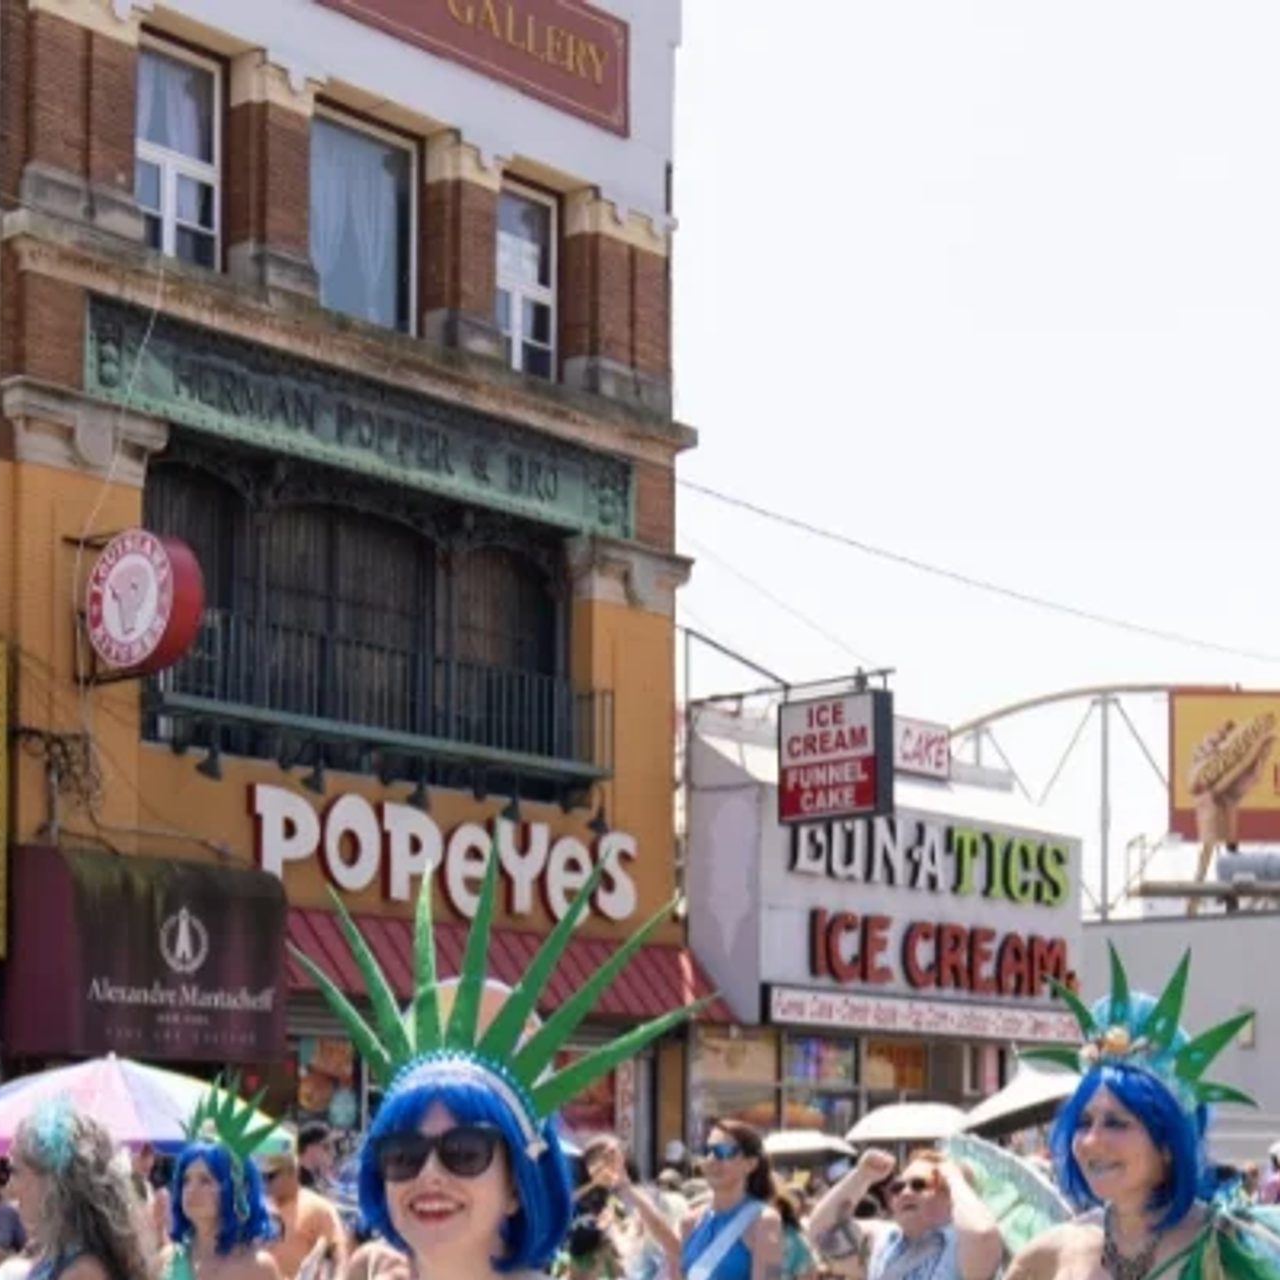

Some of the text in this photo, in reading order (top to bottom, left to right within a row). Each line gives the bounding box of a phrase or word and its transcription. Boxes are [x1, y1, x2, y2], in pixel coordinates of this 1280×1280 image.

[447, 0, 608, 86] GALLERY
[336, 400, 455, 475] POPPER
[806, 702, 844, 728] ICE
[787, 726, 867, 759] CREAM
[787, 761, 868, 791] FUNNEL
[800, 786, 856, 811] CAKE
[791, 816, 1071, 905] LUNATICS
[810, 907, 1067, 998] ICE CREAM
